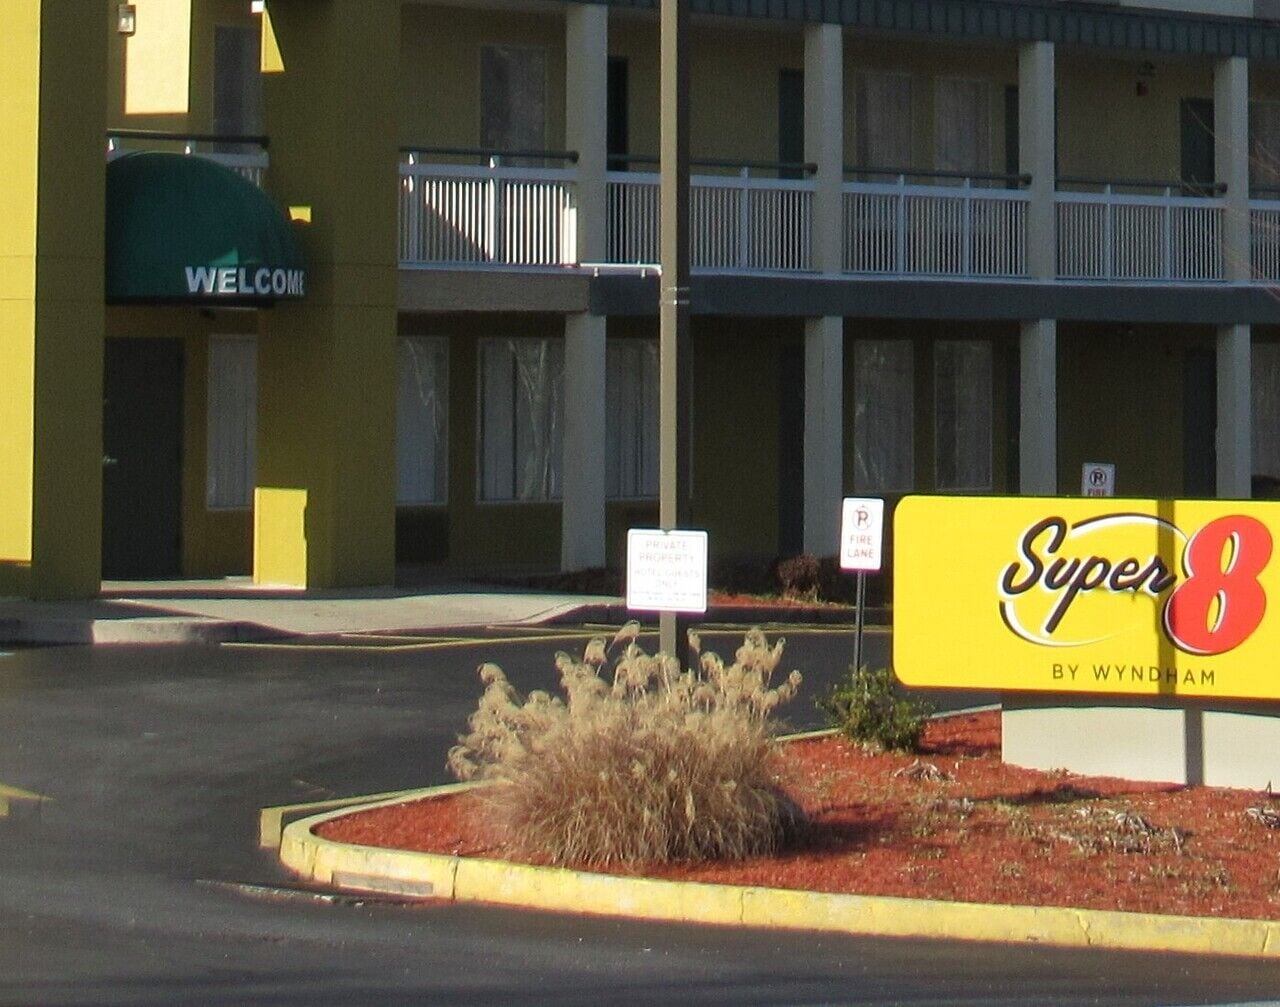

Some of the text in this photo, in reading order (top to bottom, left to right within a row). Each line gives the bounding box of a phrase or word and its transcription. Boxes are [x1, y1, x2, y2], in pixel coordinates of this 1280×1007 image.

[184, 265, 307, 296] WELCOME
[645, 539, 689, 551] PRIVATE
[850, 534, 873, 545] FIRE
[639, 552, 695, 564] PROPERTY
[847, 548, 875, 559] LANE
[1001, 514, 1273, 657] Super 8
[1052, 663, 1216, 686] BY WYNDHAM
